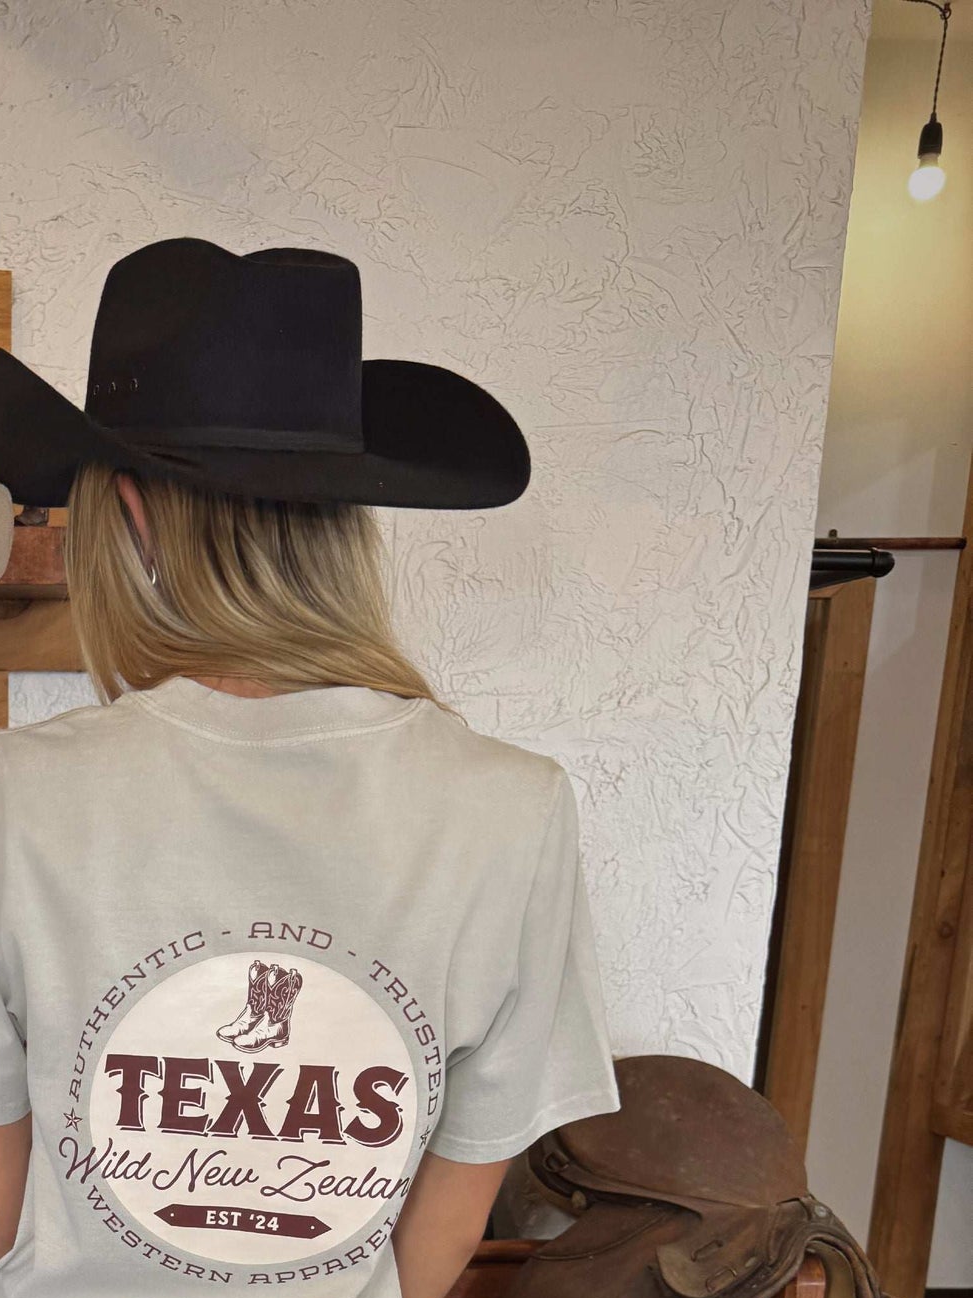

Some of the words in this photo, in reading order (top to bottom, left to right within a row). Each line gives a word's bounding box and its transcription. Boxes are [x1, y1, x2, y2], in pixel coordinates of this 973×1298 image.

[71, 930, 206, 1102] AUTHENTIC
[247, 921, 333, 950] AND
[369, 959, 442, 1117] TRUSTED
[104, 1053, 409, 1149] TEXAS
[58, 1136, 153, 1184] Wild
[152, 1147, 259, 1193] New
[260, 1154, 411, 1202] Zealan
[87, 1185, 234, 1284] WESTERN
[205, 1210, 240, 1228] EST
